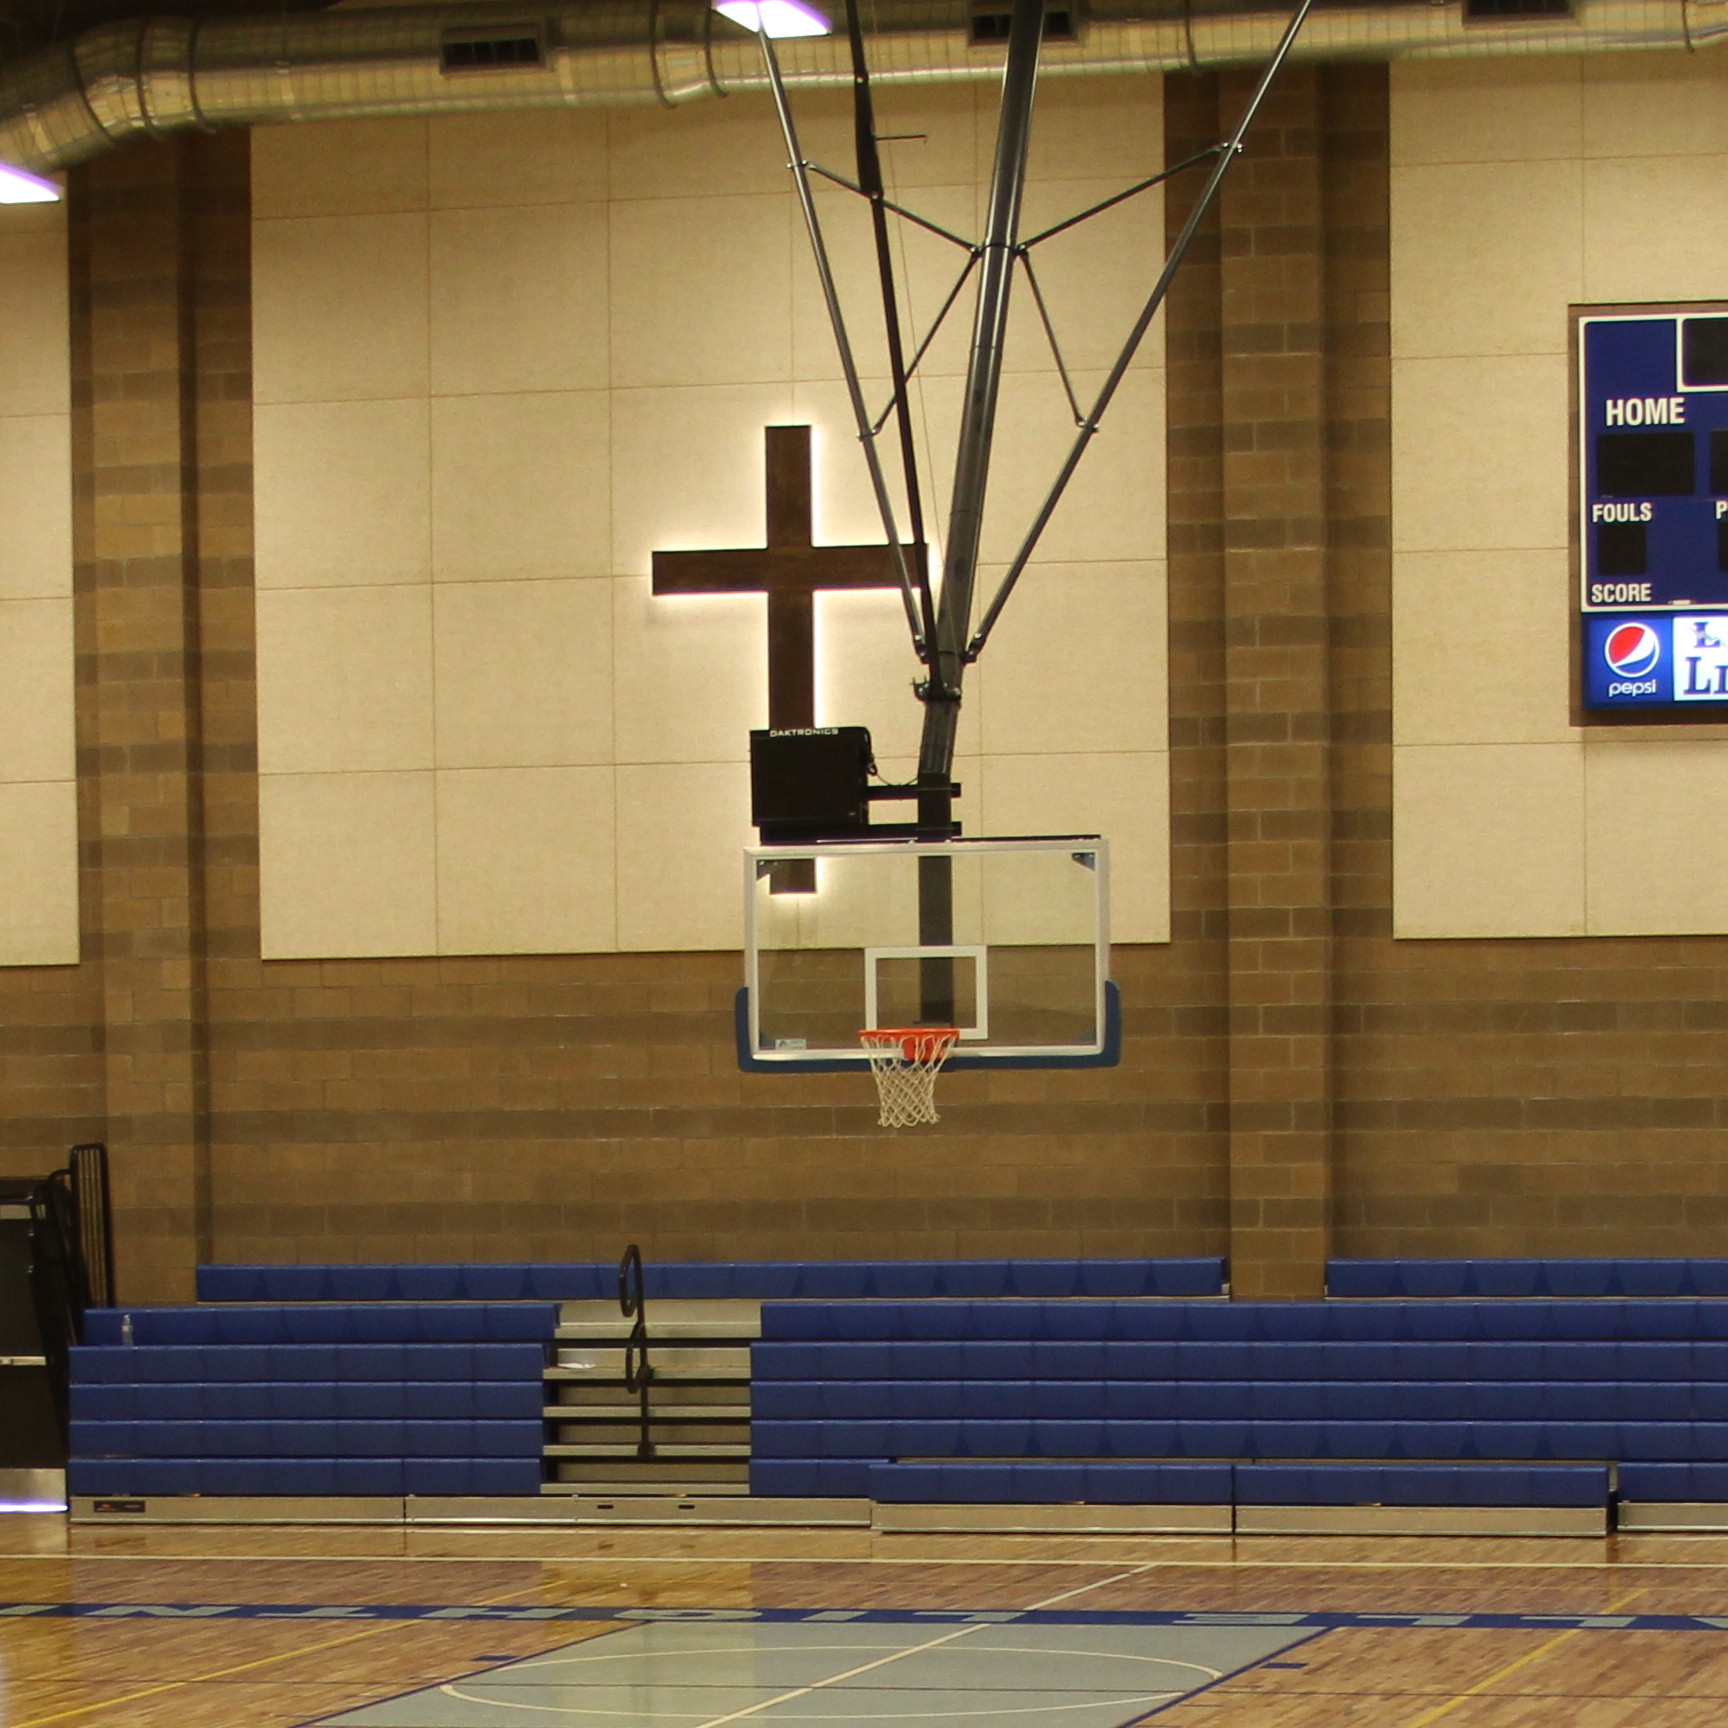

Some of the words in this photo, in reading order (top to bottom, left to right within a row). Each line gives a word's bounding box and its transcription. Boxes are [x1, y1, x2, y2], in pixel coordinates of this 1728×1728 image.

[1605, 396, 1686, 427] HOME
[1591, 502, 1653, 523] FOULS
[1591, 582, 1652, 604] SCORE
[1607, 679, 1657, 698] pepsi
[769, 727, 840, 738] DAKTRONICS
